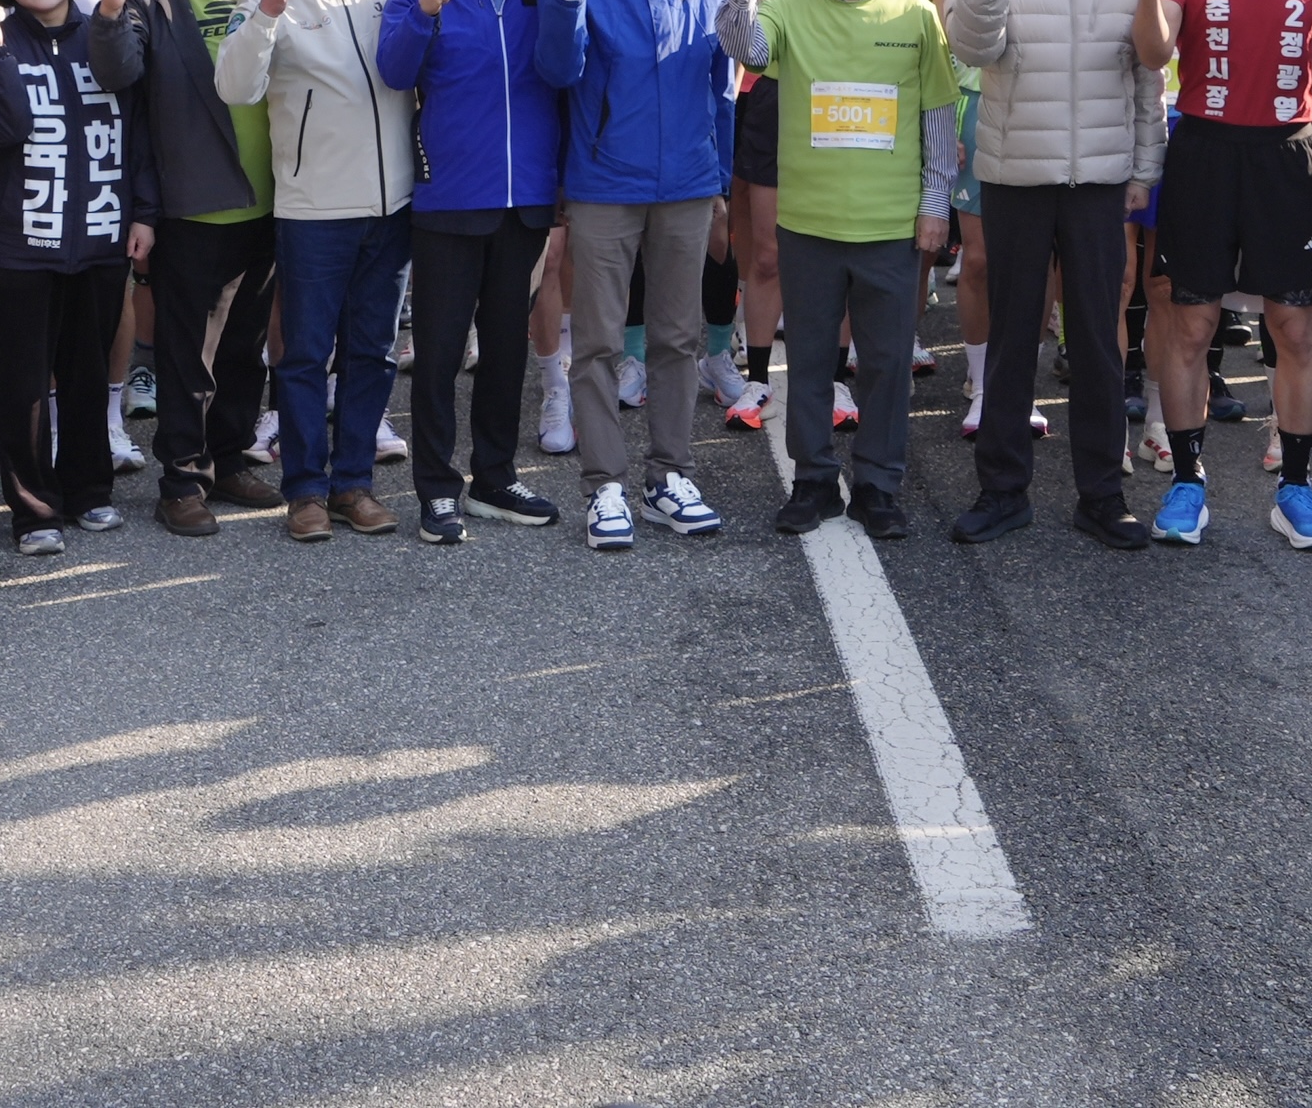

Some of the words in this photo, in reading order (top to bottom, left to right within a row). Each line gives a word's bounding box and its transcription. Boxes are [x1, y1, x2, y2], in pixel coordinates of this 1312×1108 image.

[1284, 0, 1304, 27] 2
[874, 41, 919, 49] SKECHERS
[1273, 32, 1303, 123] 정광열
[828, 105, 872, 124] 5001
[17, 63, 69, 239] 교육감
[27, 238, 61, 249] 예비후보
